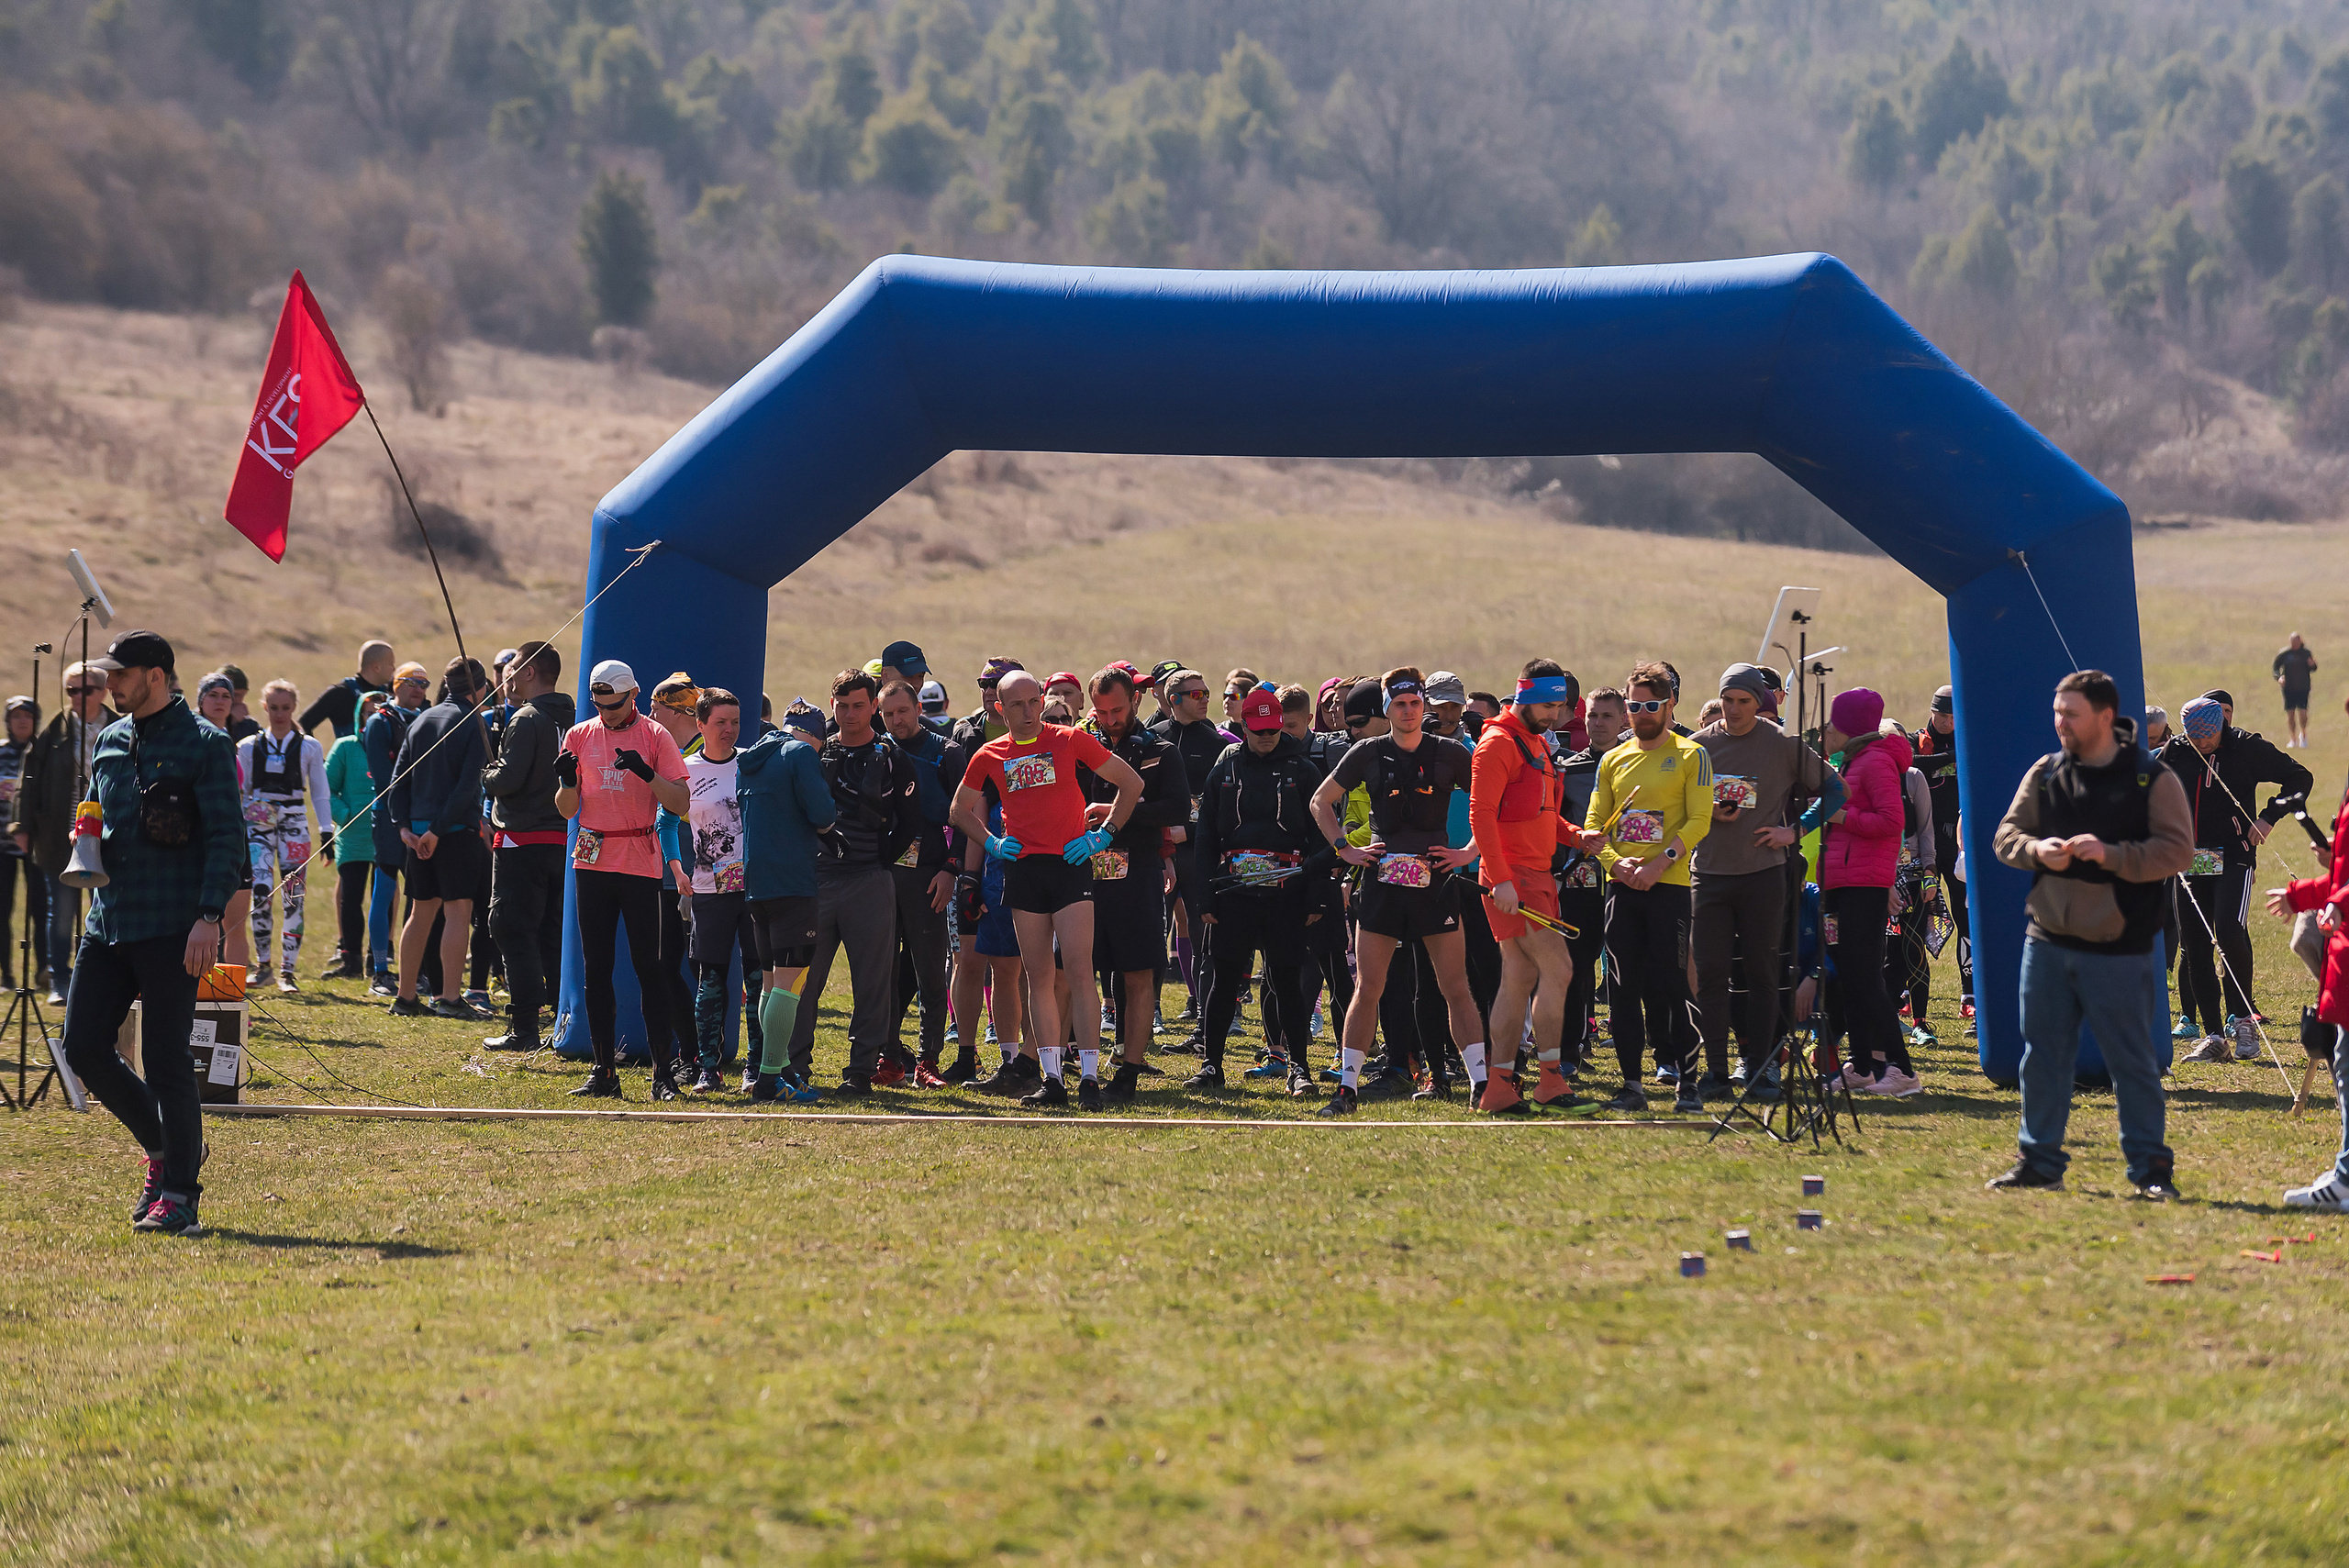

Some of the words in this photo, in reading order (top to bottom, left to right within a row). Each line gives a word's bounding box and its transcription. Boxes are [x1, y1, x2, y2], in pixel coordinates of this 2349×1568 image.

[266, 367, 294, 405] DEVELOPMENT
[603, 770, 624, 782] EPIC
[1014, 763, 1044, 787] 105
[1717, 784, 1746, 805] 169
[1623, 818, 1652, 840] 226
[1388, 862, 1419, 884] 228
